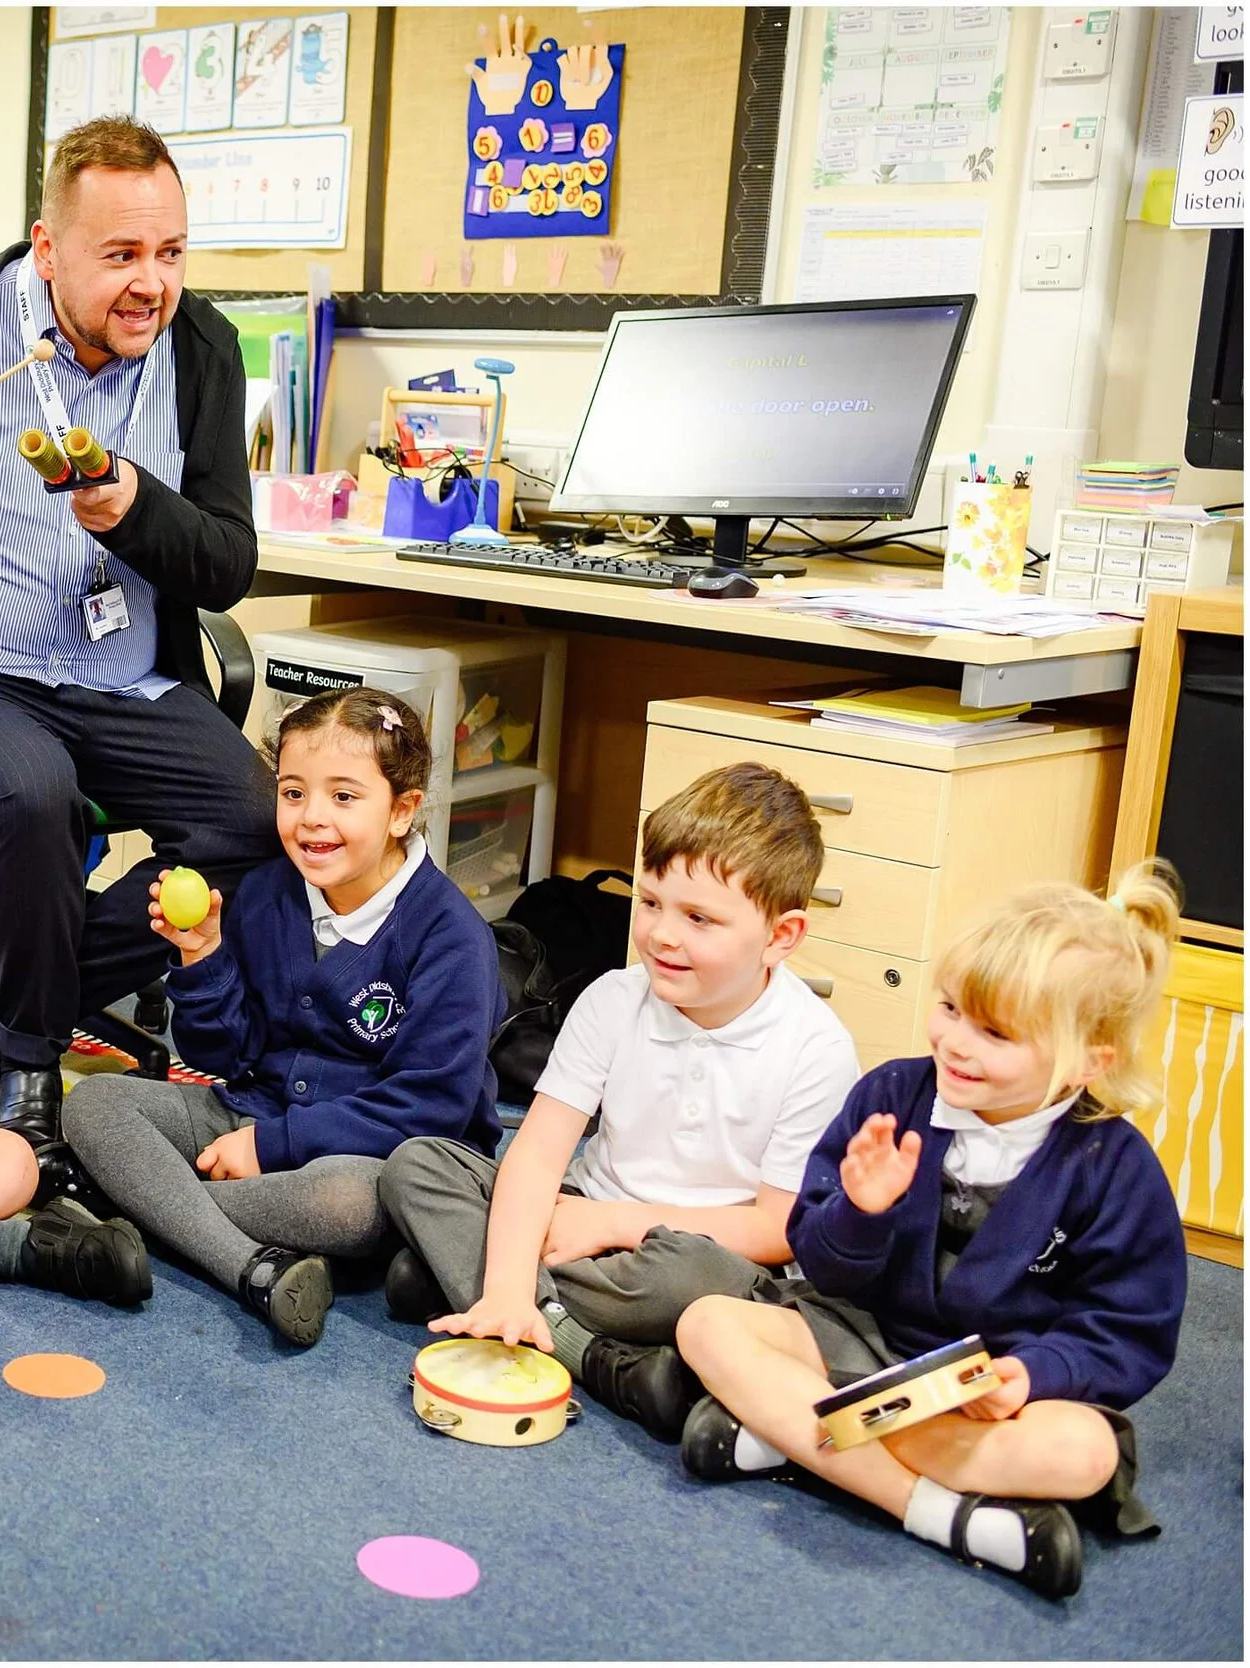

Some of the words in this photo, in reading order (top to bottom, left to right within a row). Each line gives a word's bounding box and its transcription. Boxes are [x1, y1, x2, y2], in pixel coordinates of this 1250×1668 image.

[478, 136, 491, 156] 5
[524, 128, 535, 148] 1
[588, 129, 599, 149] 6
[292, 178, 300, 192] 9
[316, 176, 330, 191] 10
[751, 399, 804, 413] door
[812, 398, 875, 416] open.
[268, 663, 304, 682] Teacher
[348, 987, 370, 1008] West
[347, 1017, 379, 1043] Primary
